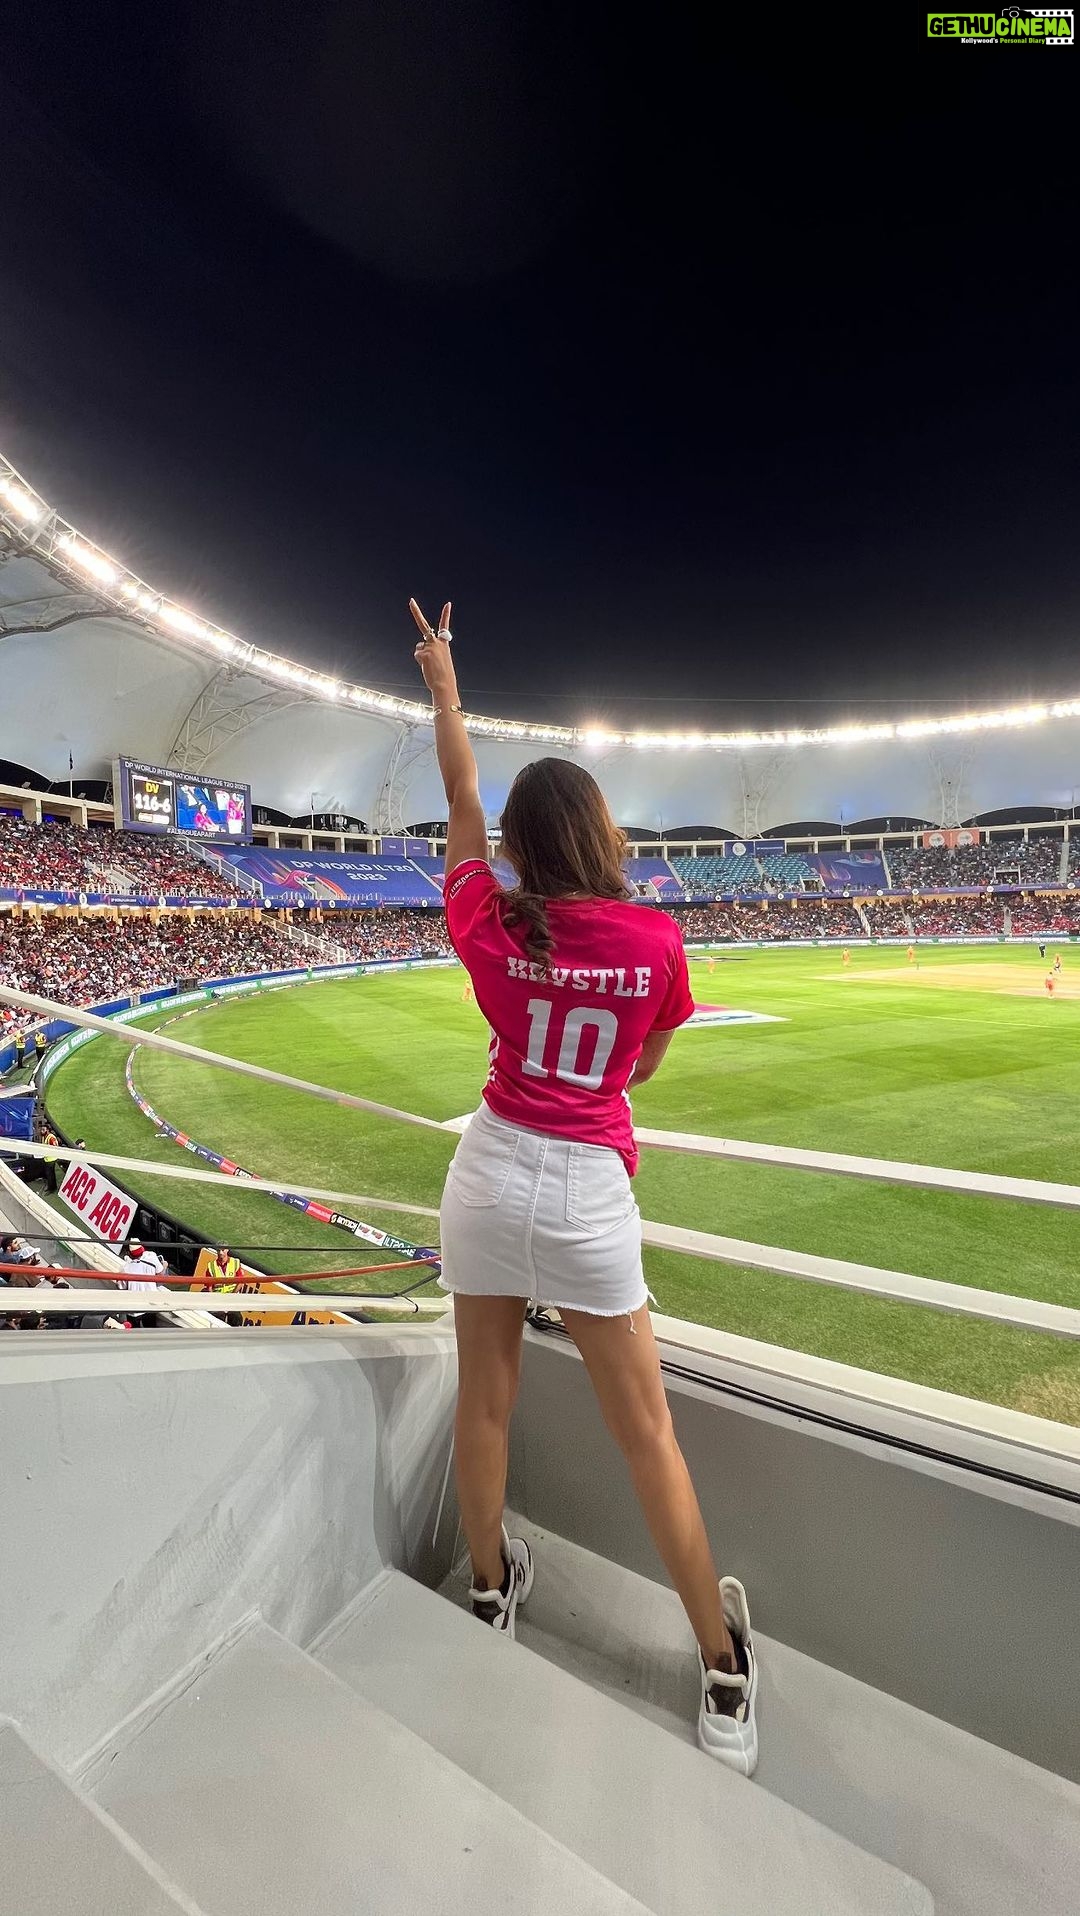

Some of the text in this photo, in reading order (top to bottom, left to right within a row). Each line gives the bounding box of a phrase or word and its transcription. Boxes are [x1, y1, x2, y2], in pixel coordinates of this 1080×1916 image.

[125, 761, 135, 769] DP
[135, 762, 157, 774] WORLD
[156, 768, 201, 783] INTERNATIONAL
[201, 777, 223, 787] LEAGUE
[145, 782, 160, 793] DV
[135, 793, 171, 813] 116-6
[290, 860, 415, 872] DP WORLD ILT20
[347, 872, 388, 881] 2023
[521, 998, 618, 1091] 10
[61, 1166, 131, 1242] ACC ACC
